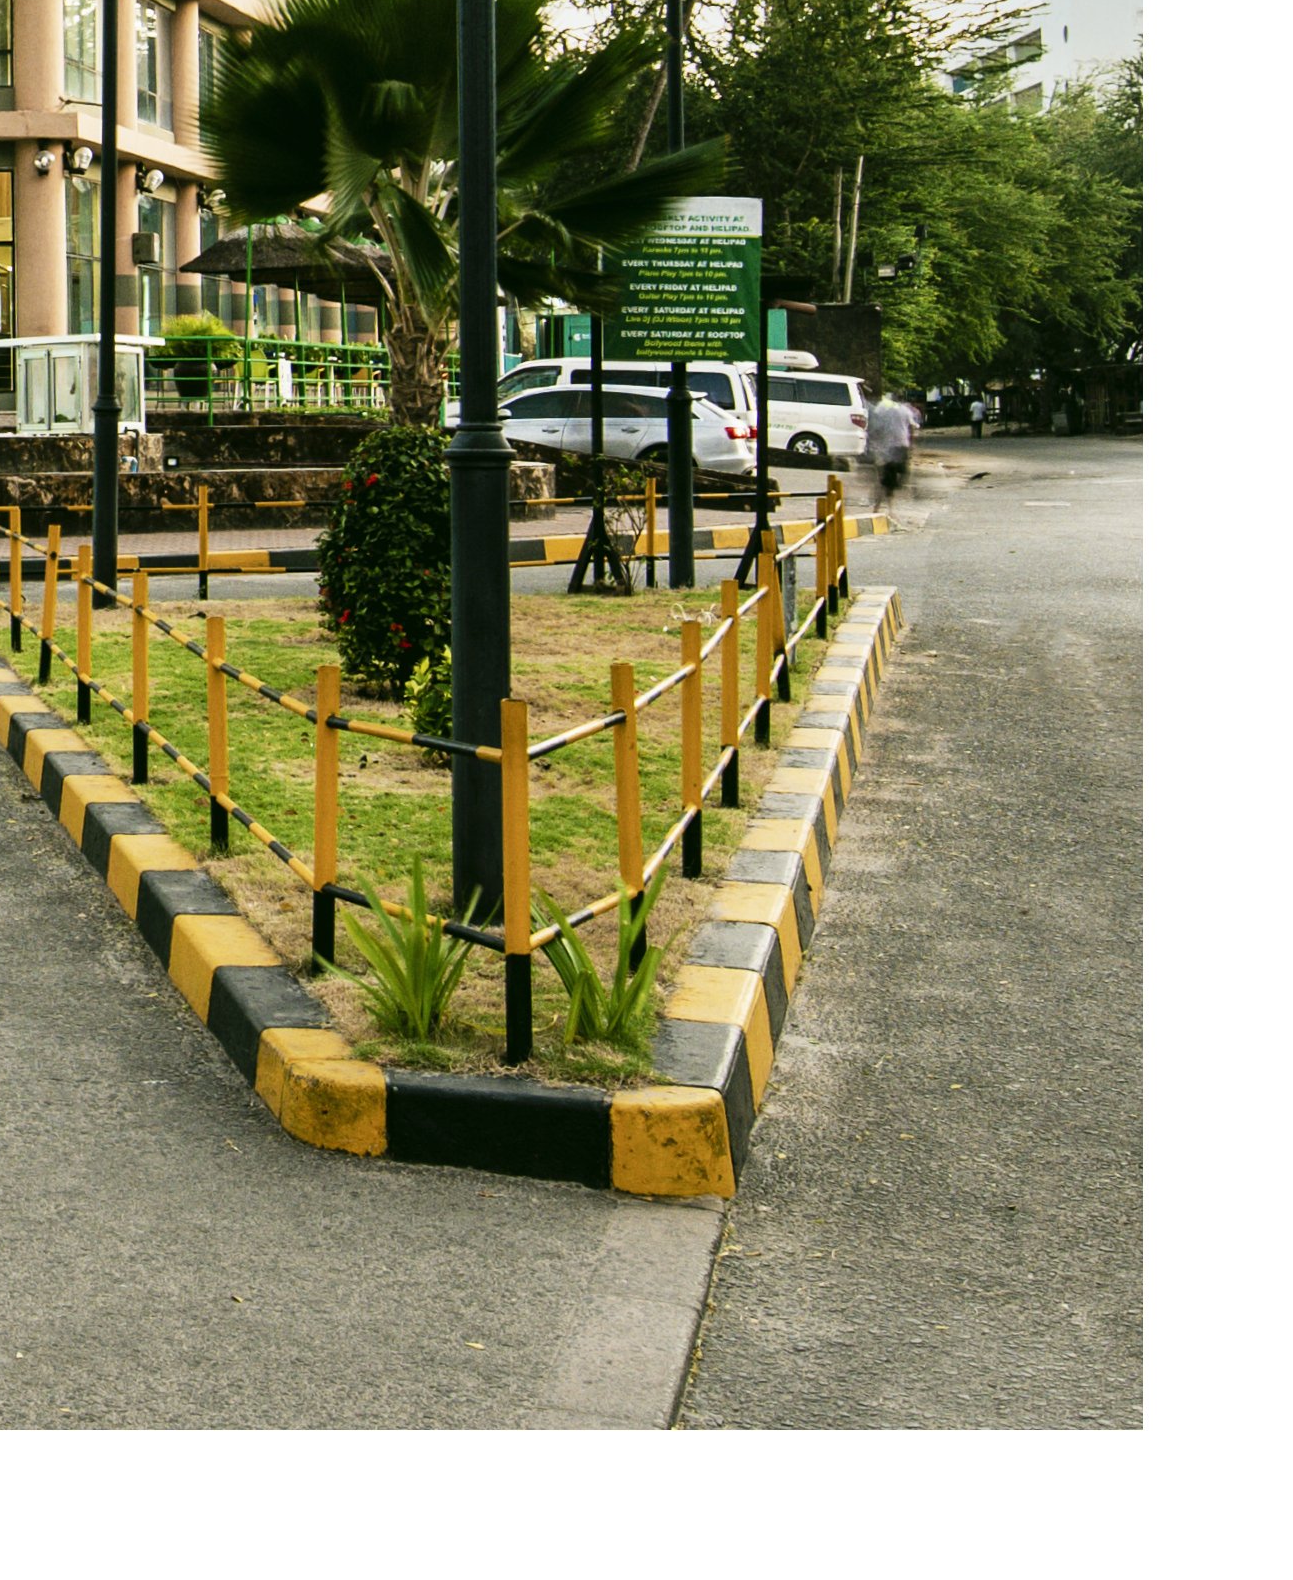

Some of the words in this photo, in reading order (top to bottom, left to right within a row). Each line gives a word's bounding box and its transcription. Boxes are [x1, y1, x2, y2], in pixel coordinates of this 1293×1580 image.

[709, 261, 743, 269] HELIPAD
[659, 283, 688, 291] FRIDAY
[702, 284, 738, 292] HELIPAD
[653, 306, 696, 314] SATURDAY
[710, 307, 745, 315] HELIPAD
[621, 330, 648, 338] EVERY
[650, 330, 693, 338] SATURDAY
[708, 331, 746, 339] ROOFTOP
